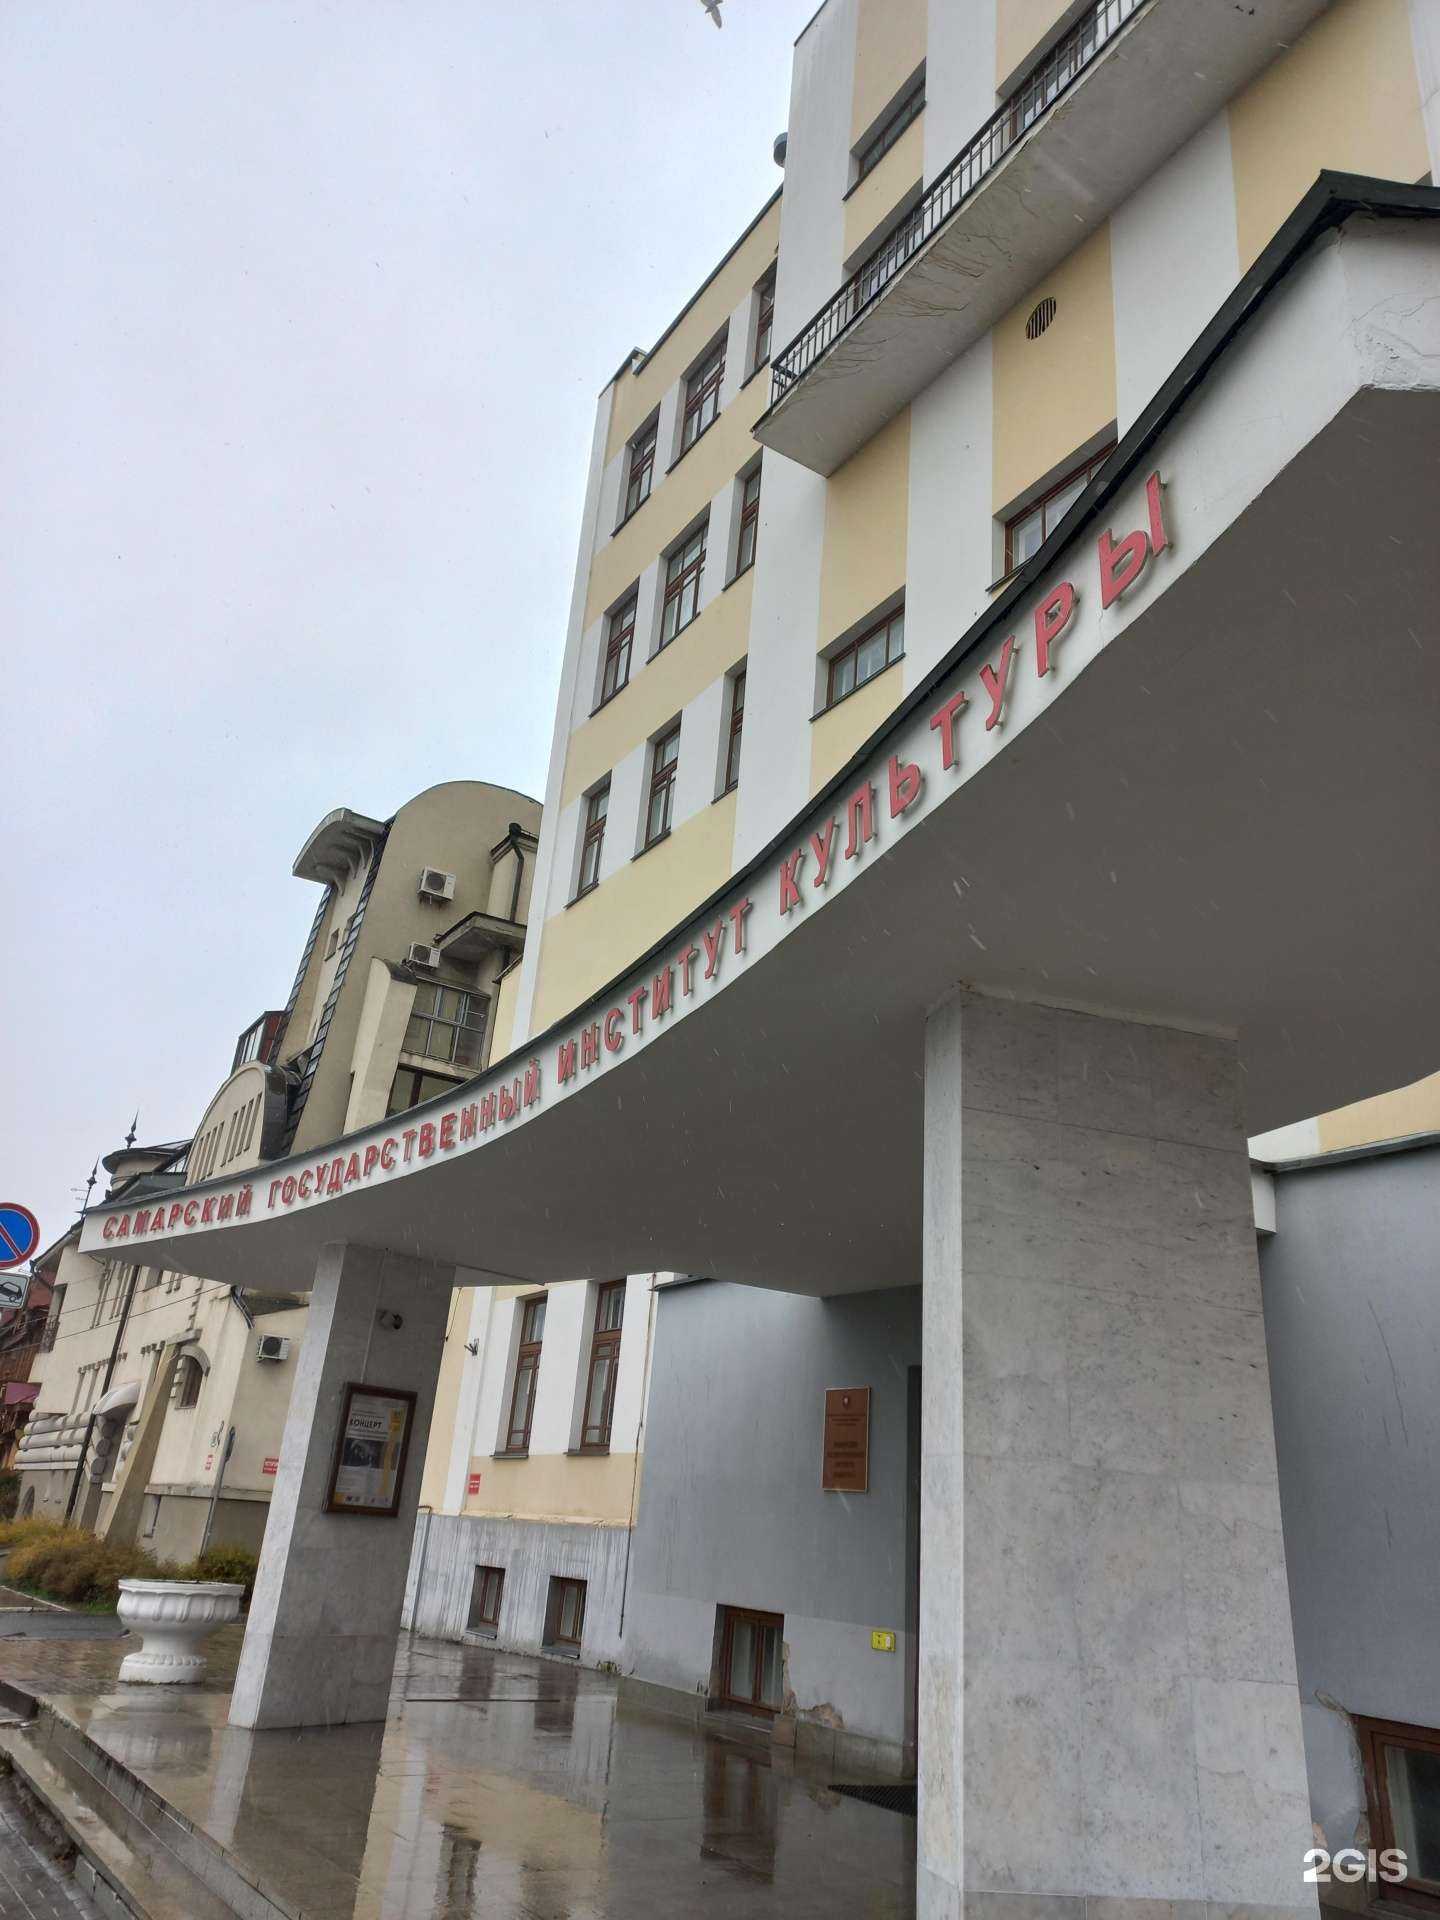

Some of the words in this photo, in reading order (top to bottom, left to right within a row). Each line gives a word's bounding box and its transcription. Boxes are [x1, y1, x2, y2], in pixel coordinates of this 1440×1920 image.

[102, 1184, 253, 1239] САМАРСКИЙ
[268, 1059, 541, 1210] ГОСУДАРСТВЕННЫЙ
[557, 897, 752, 1085] ИНСТИТУТ
[778, 471, 1172, 914] КУЛЬТУРЫ
